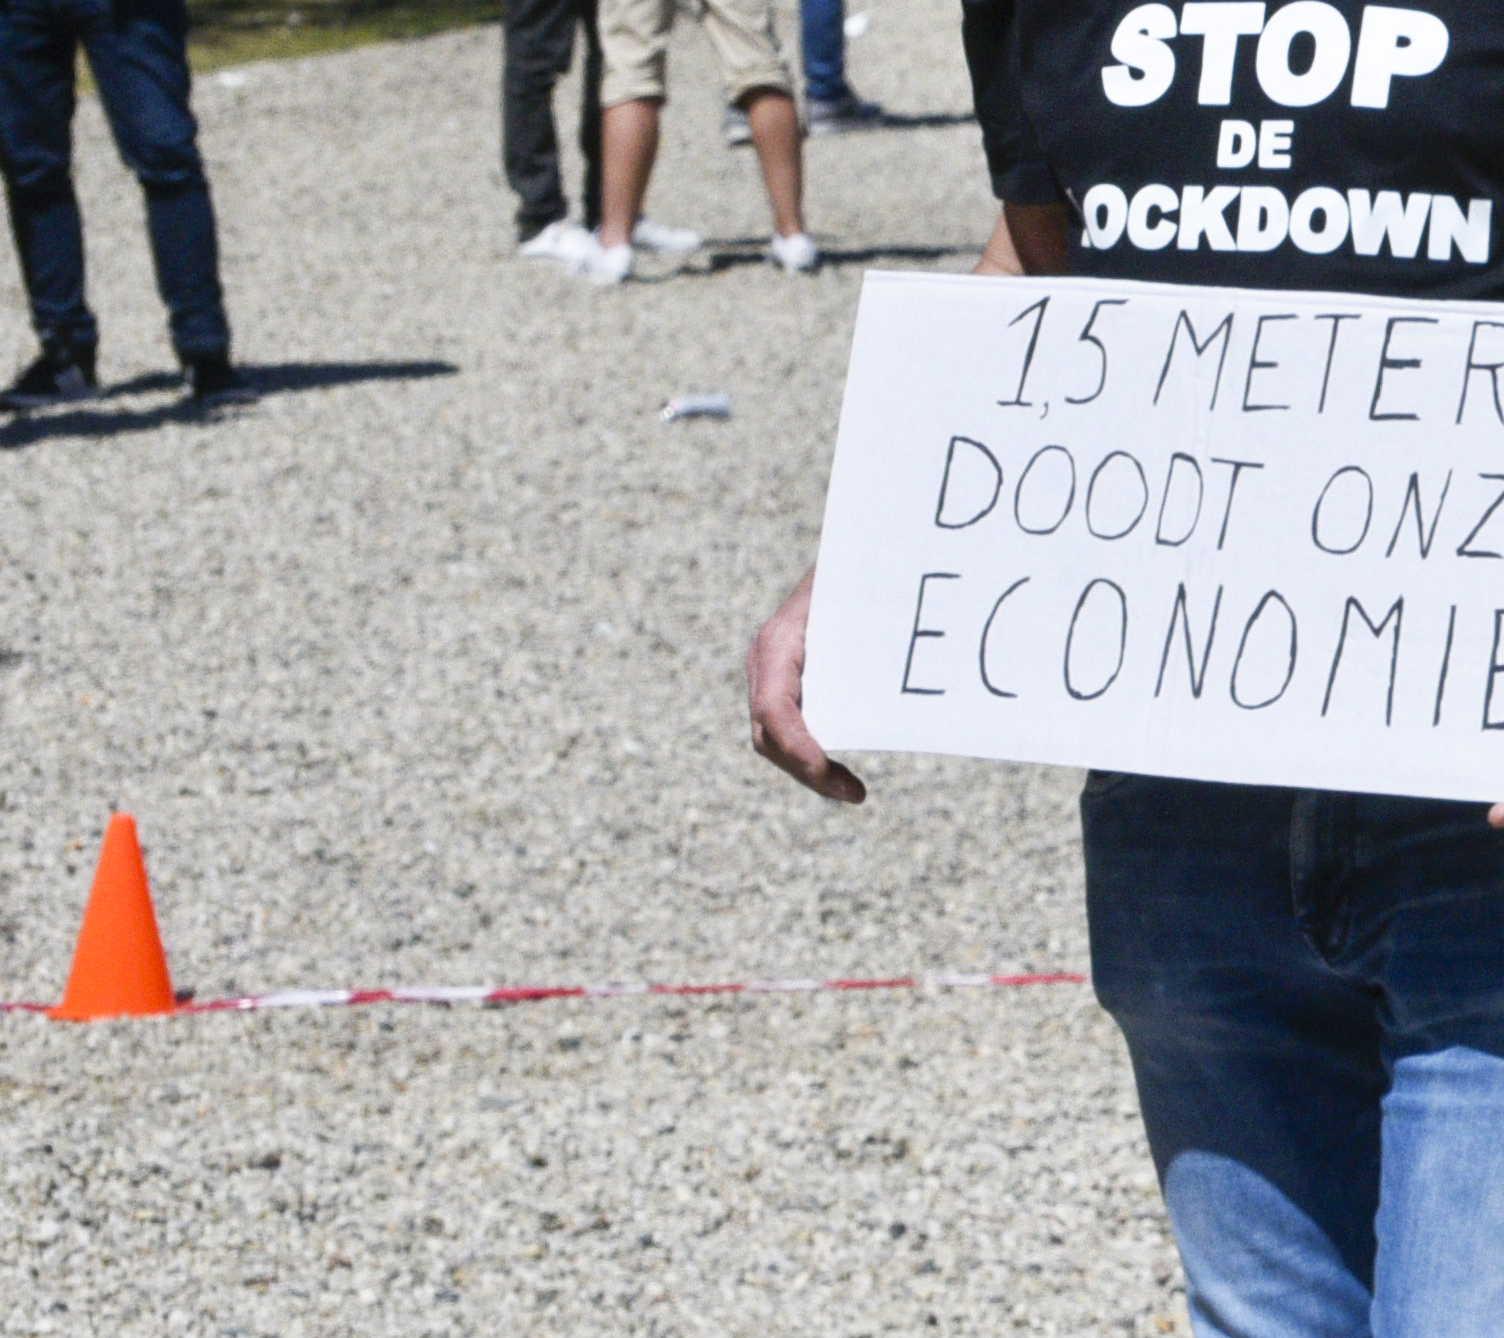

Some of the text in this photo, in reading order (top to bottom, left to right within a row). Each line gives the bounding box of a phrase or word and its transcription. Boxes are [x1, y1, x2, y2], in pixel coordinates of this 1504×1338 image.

[1101, 0, 1450, 110] STOP
[1216, 119, 1295, 169] DE
[1079, 182, 1493, 263] OCKDOWN
[996, 296, 1130, 422] 1,5
[933, 435, 1265, 551] DOODT
